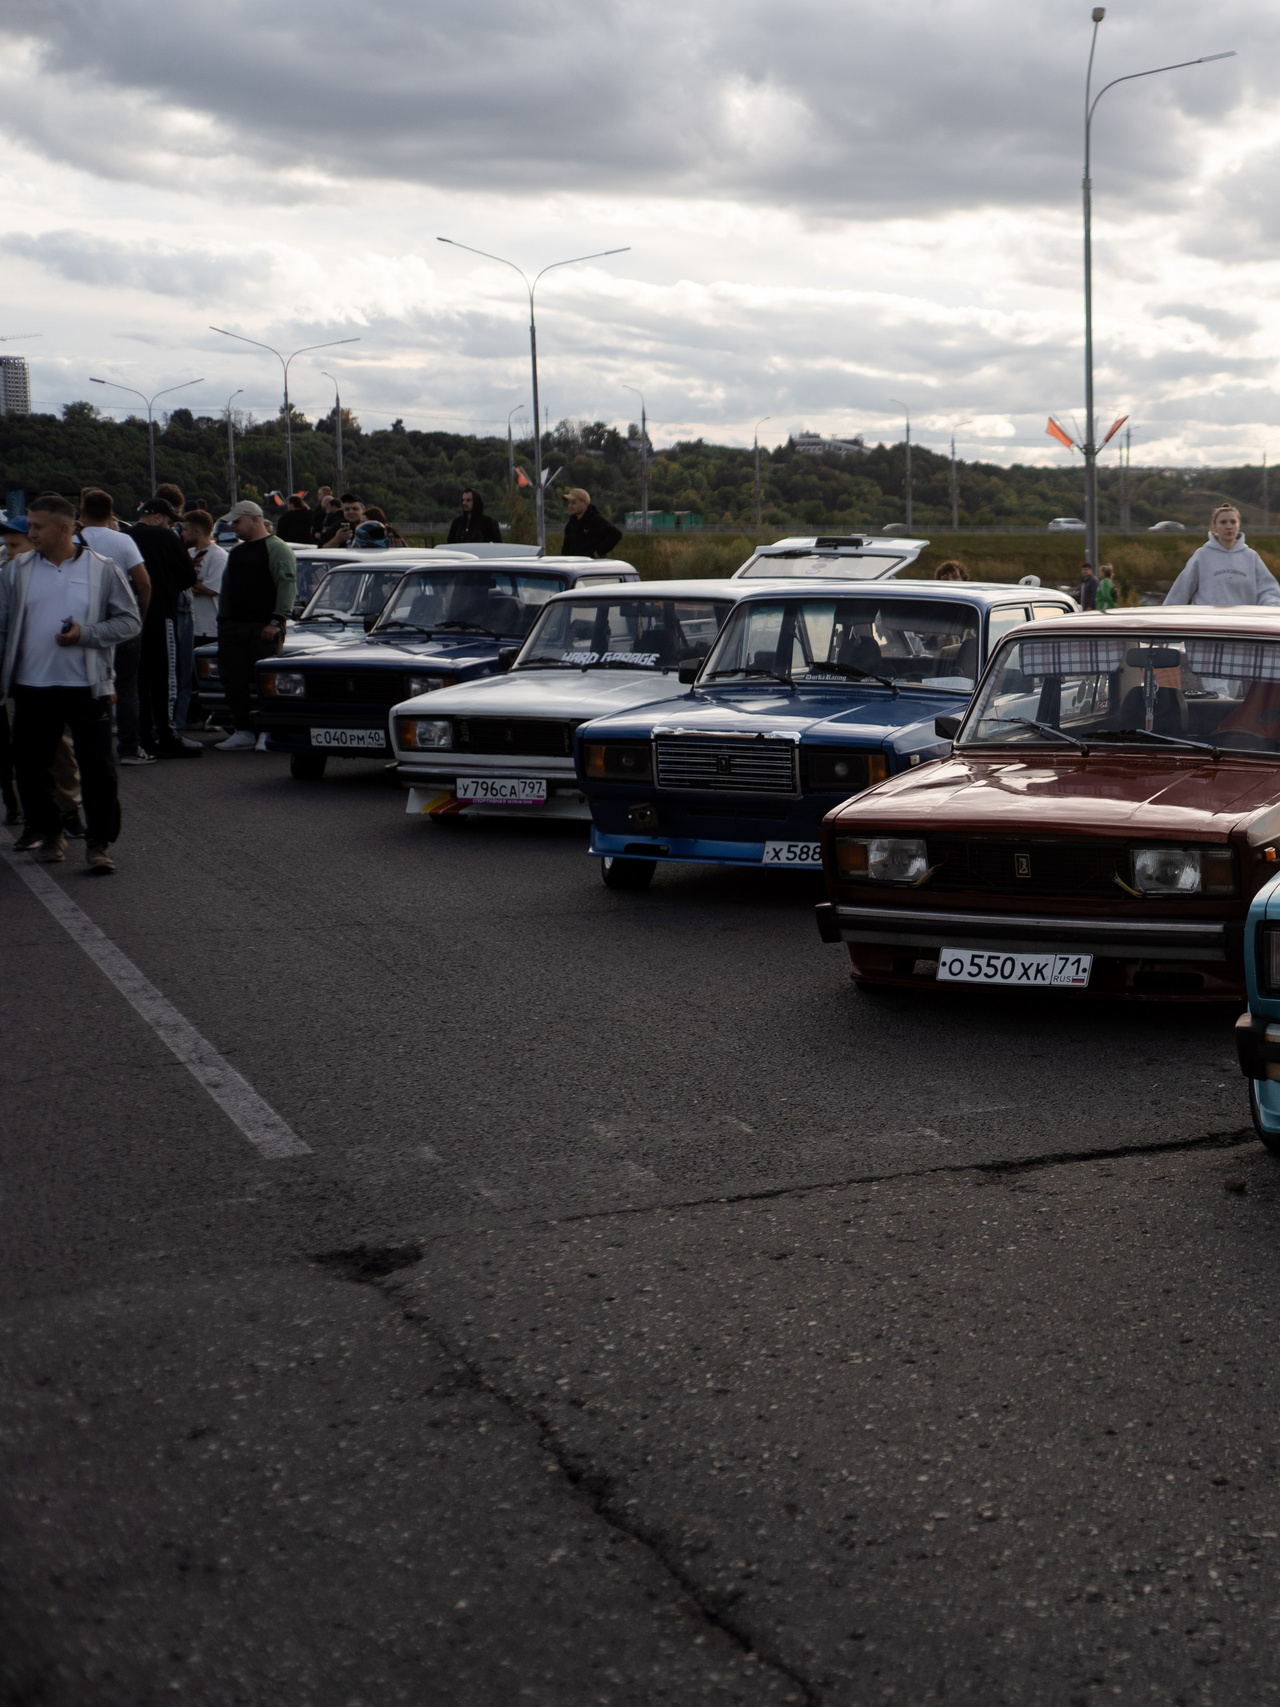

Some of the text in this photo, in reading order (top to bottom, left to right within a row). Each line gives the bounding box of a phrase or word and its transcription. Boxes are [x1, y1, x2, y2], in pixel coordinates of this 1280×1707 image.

[368, 731, 380, 742] 40
[520, 781, 542, 793] 797
[1058, 957, 1082, 976] 71
[1053, 975, 1071, 983] RUS
